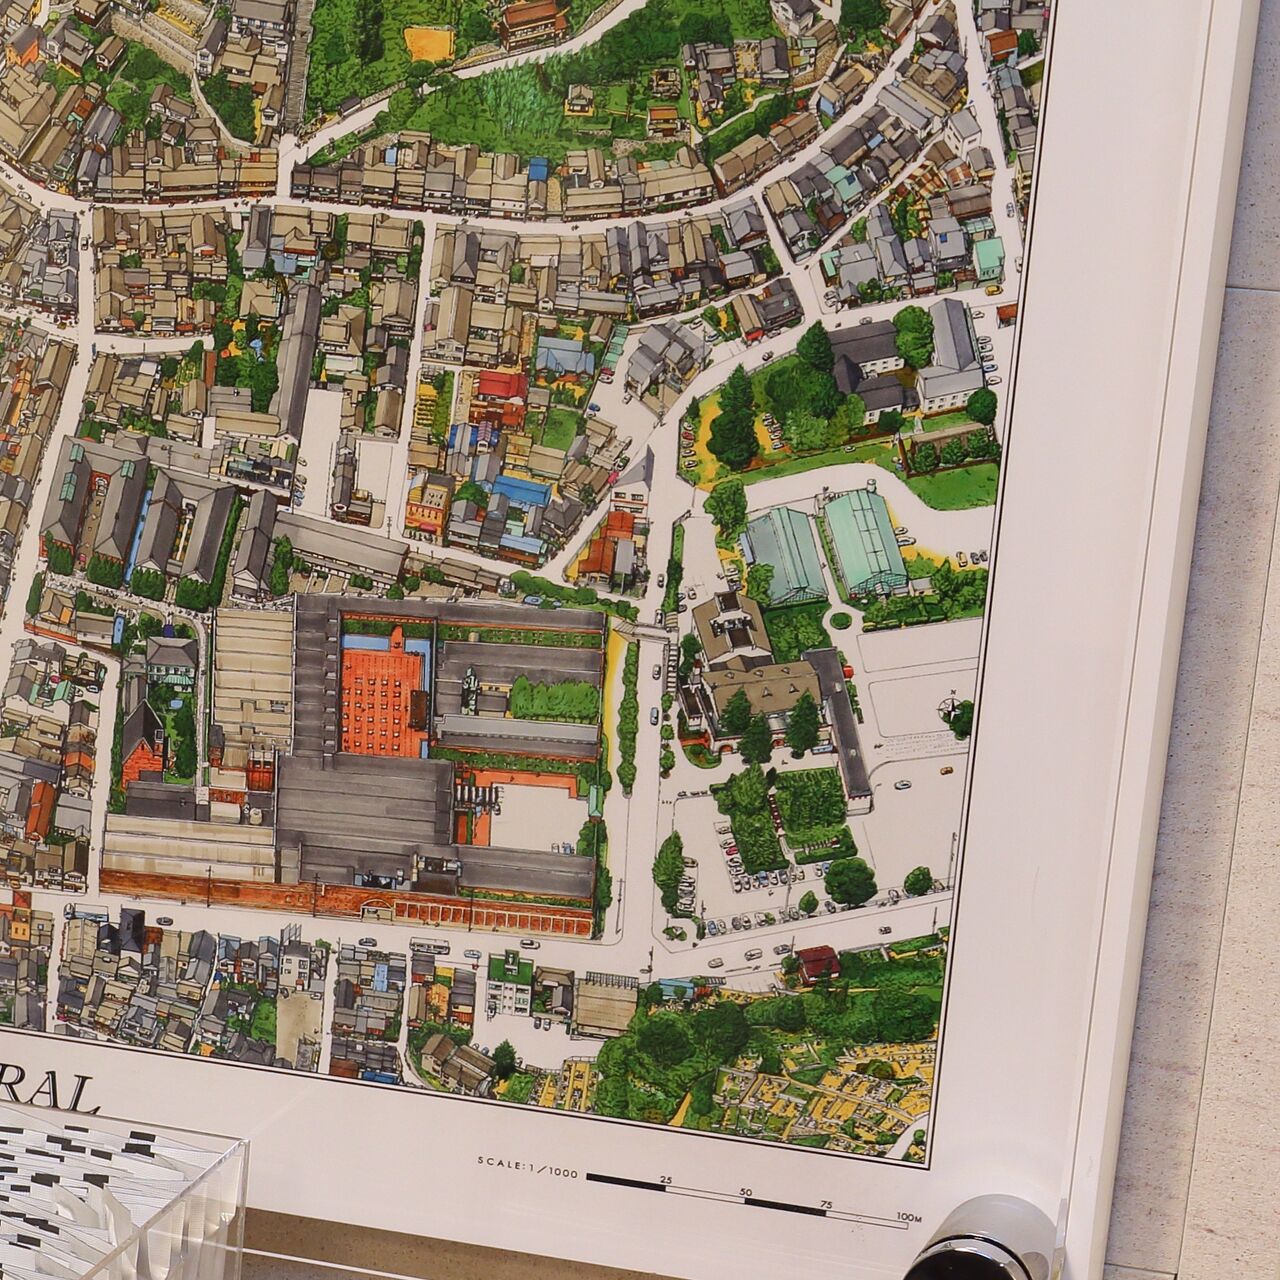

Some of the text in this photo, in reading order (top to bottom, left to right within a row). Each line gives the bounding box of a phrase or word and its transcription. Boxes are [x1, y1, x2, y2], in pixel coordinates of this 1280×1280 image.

[659, 1175, 673, 1185] 25
[739, 1188, 752, 1197] 50
[820, 1200, 833, 1209] 75
